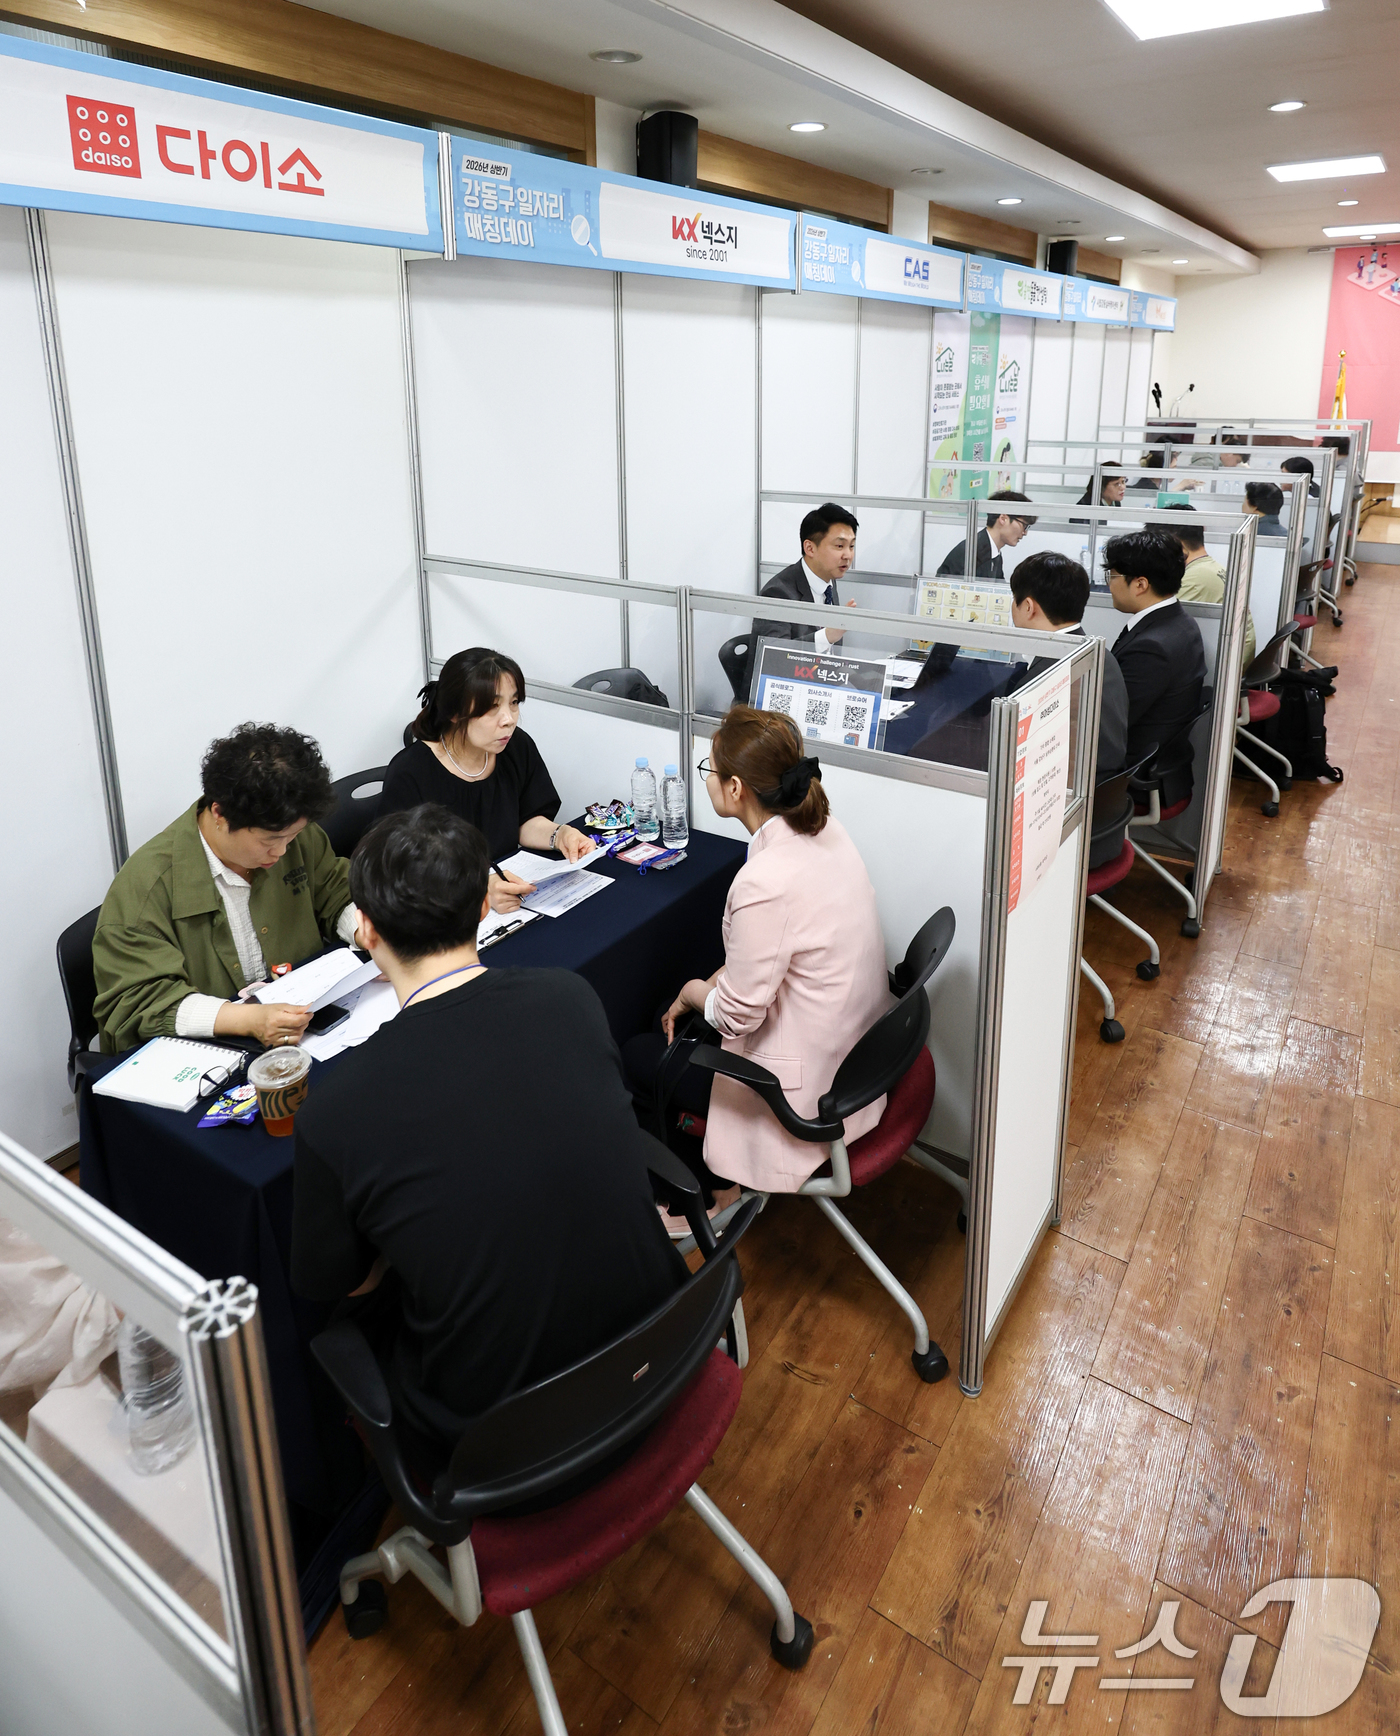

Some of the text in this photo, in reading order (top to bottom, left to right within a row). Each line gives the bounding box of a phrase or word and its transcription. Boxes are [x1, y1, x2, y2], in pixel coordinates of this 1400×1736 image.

[81, 147, 132, 169] daiso
[155, 124, 325, 197] 다이소
[466, 159, 508, 177] 2026년 상반기
[464, 212, 535, 248] 매칭데이
[686, 245, 728, 262] since 2001
[804, 261, 836, 284] 매칭데이
[904, 257, 930, 281] CAS
[787, 653, 813, 663] Innovation
[816, 657, 841, 668] Challenge
